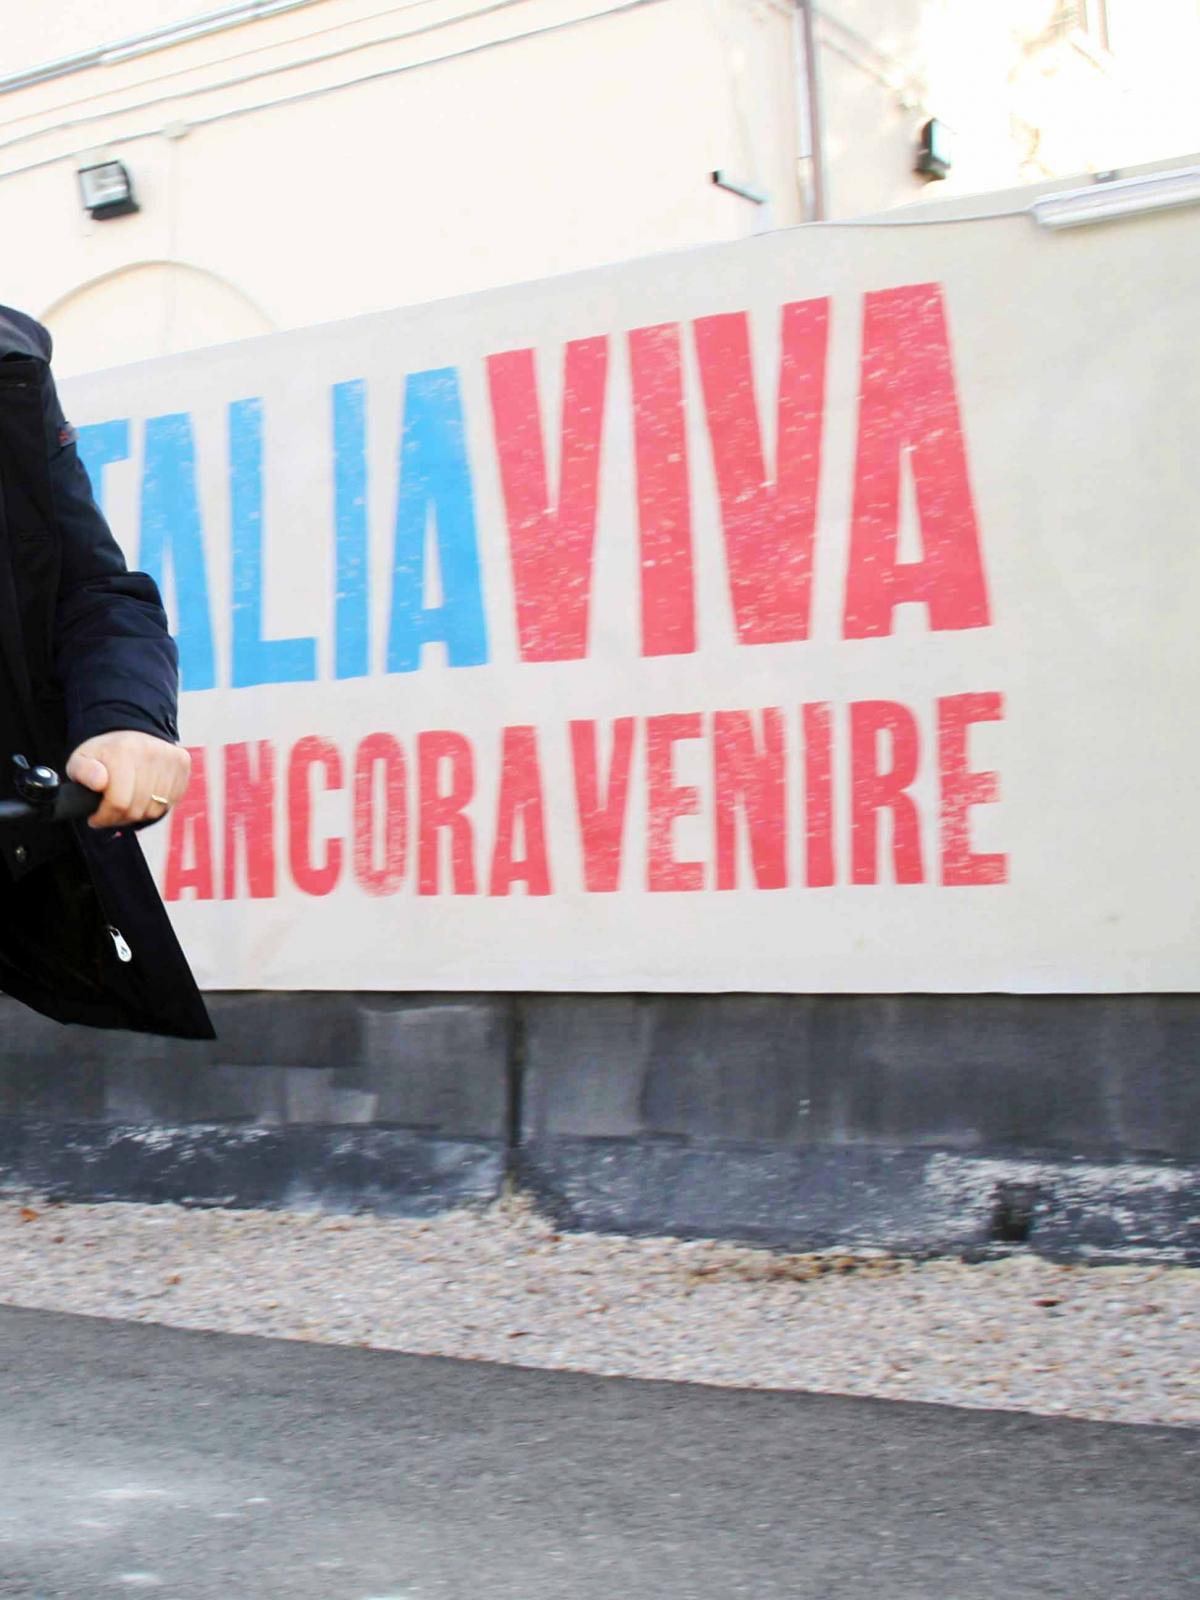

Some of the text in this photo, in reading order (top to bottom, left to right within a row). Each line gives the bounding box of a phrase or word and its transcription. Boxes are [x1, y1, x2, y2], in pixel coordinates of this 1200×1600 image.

[76, 281, 992, 693] ALIA VIVA
[163, 691, 1010, 901] ANCORA VENIRE
